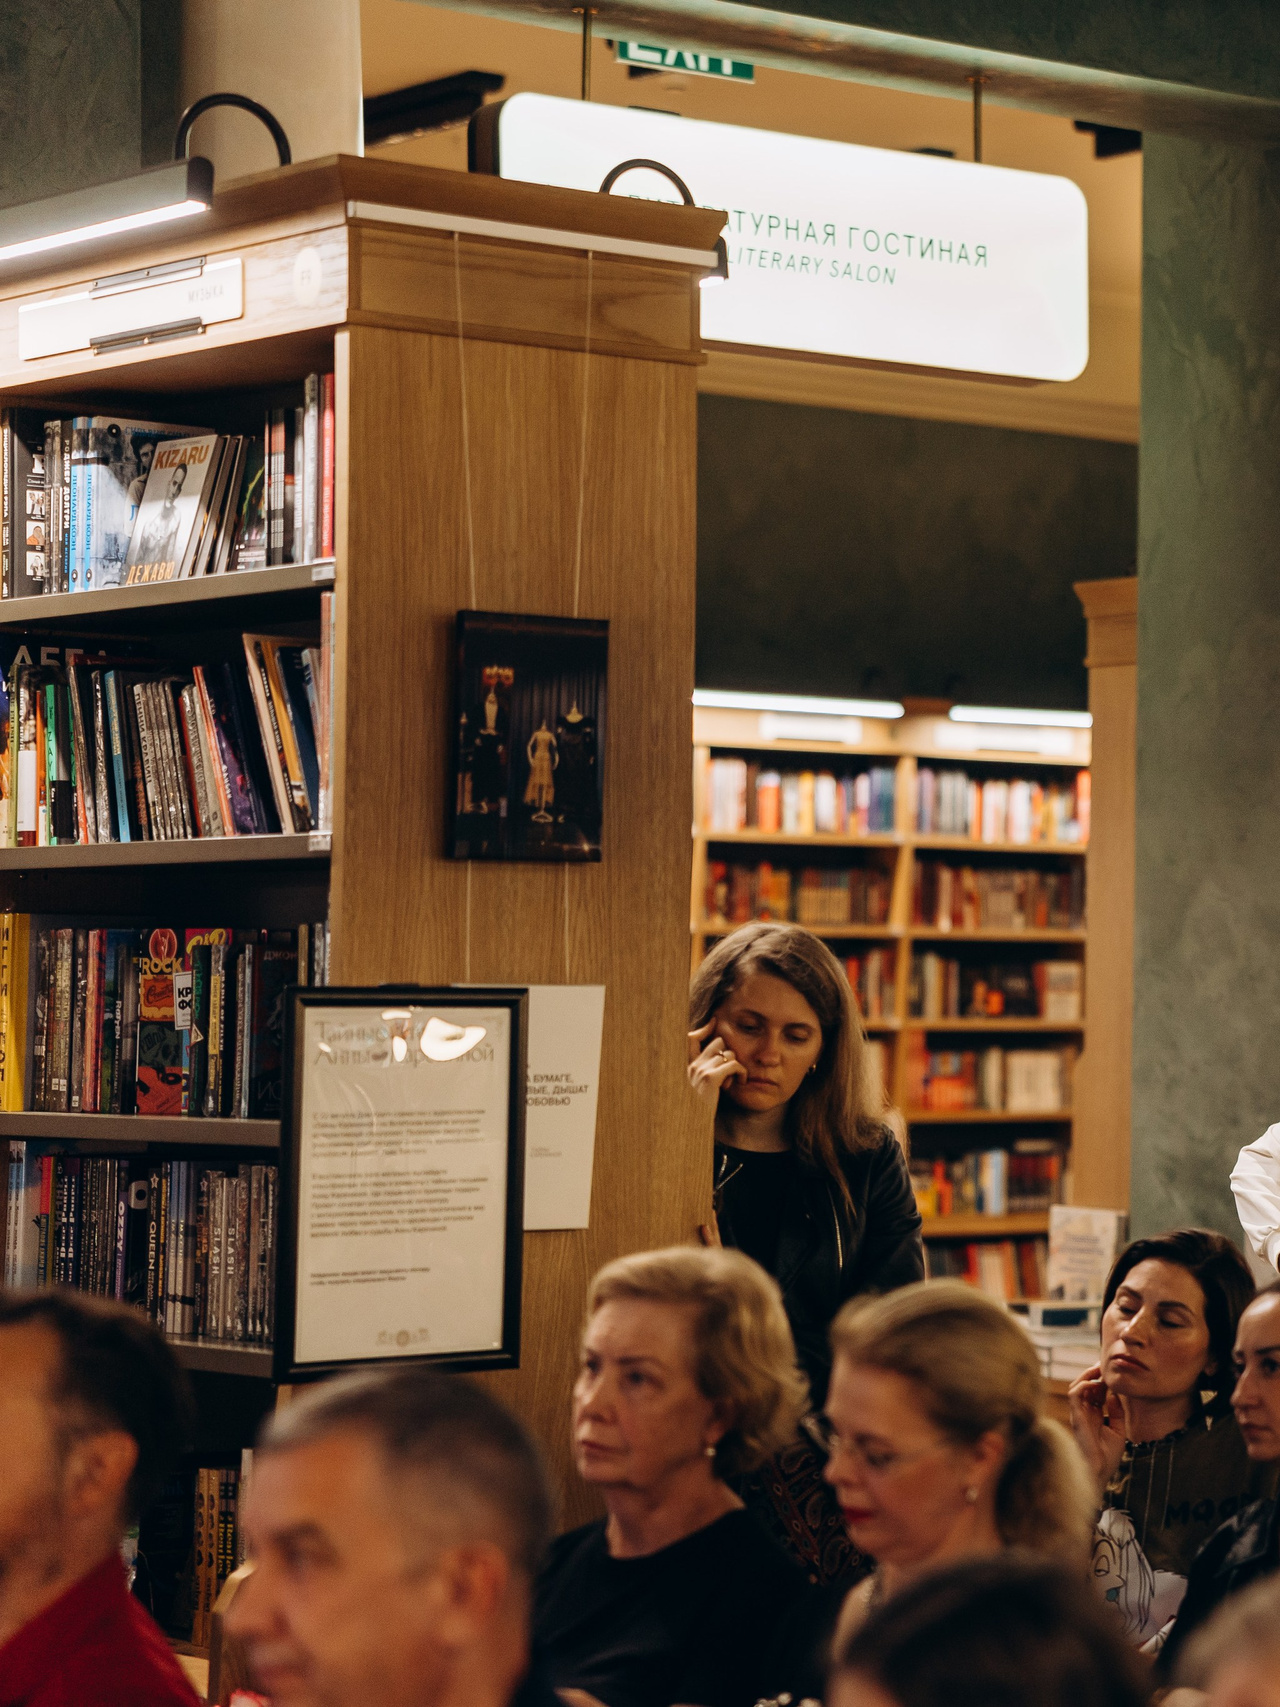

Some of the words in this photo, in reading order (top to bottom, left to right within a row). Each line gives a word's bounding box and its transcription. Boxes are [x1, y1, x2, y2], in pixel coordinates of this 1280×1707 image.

[727, 245, 824, 275] LITERARY
[829, 260, 897, 286] SALON
[848, 226, 989, 268] ГОСТИНАЯ
[154, 444, 210, 471] KIZARU
[126, 561, 174, 586] ДЕЖАВЮ
[141, 956, 183, 975] ROCK
[552, 1084, 589, 1096] ДЫШАТ
[116, 1200, 126, 1253] OZZY
[148, 1221, 157, 1269] QUEEN
[213, 1227, 221, 1275] SLASH
[227, 1227, 235, 1275] SLASH
